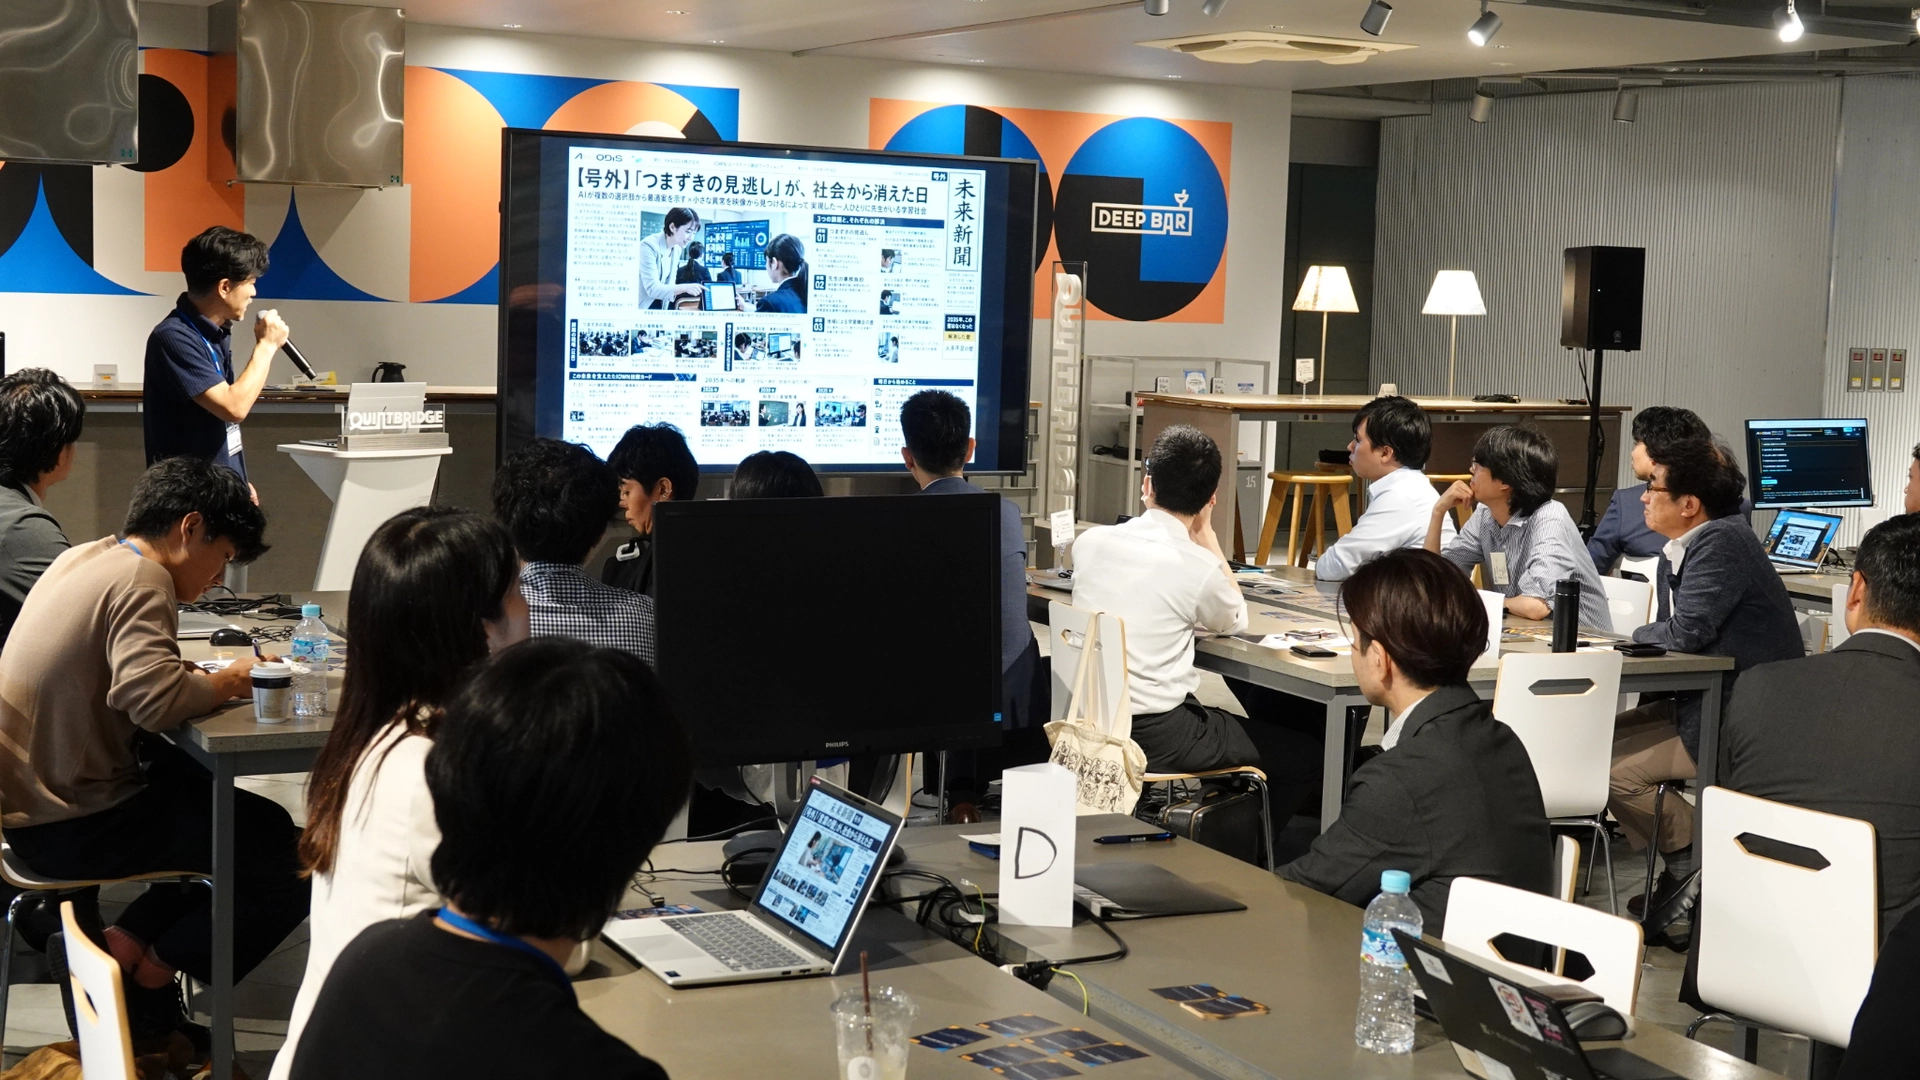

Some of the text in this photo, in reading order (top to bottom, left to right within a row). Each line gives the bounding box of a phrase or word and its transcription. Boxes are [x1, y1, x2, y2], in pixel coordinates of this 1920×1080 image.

[578, 166, 928, 204] 【号外】「つまずきの見逃し」が、社会から消えた日
[952, 178, 976, 267] 未来新聞
[1099, 209, 1186, 231] DEEP BAR
[816, 234, 826, 243] 01
[814, 281, 824, 290] 02
[813, 323, 823, 332] 03
[349, 410, 443, 430] QUINTBRIDGE
[1014, 826, 1057, 880] D
